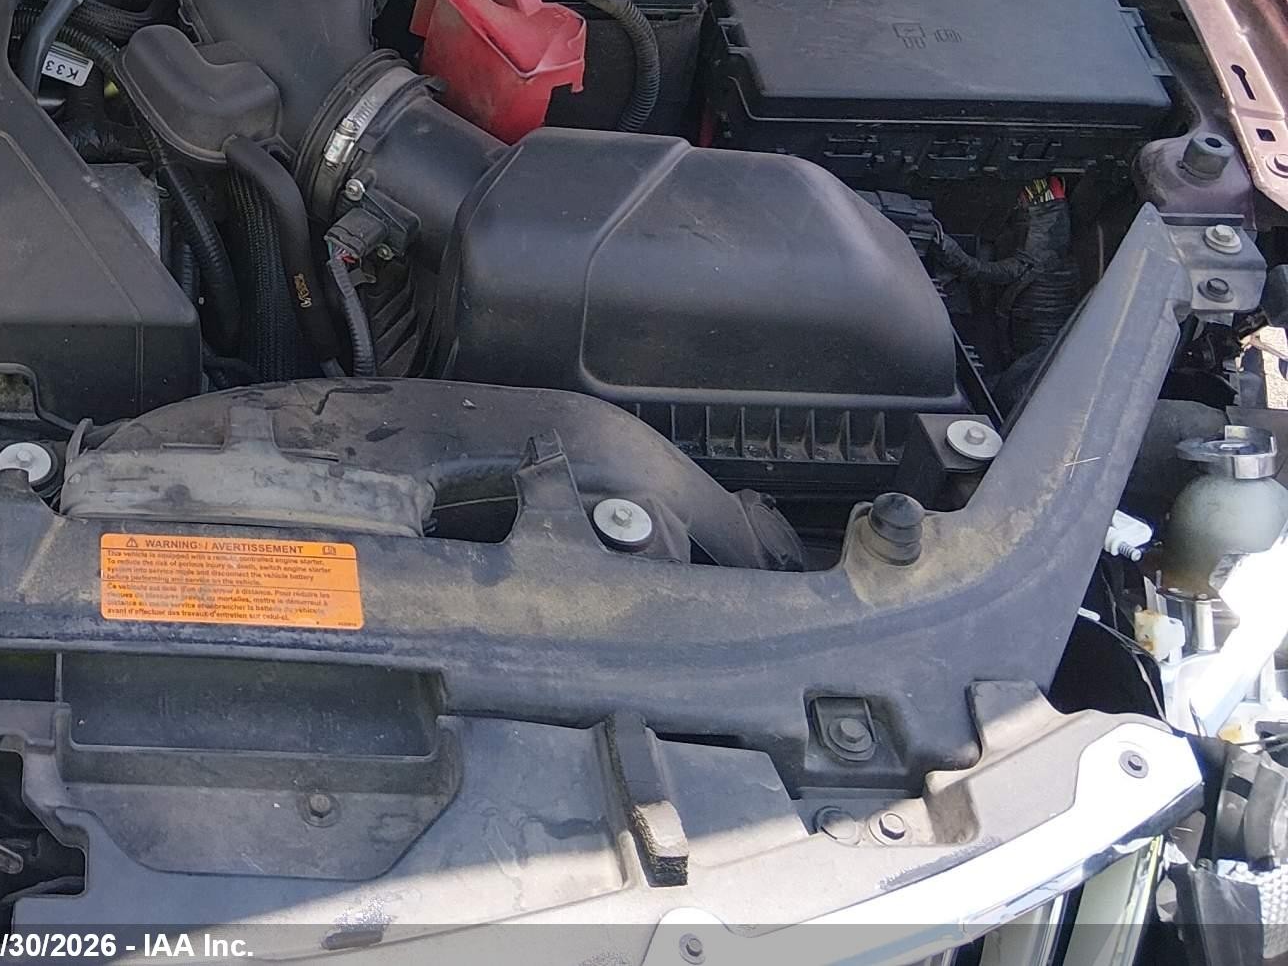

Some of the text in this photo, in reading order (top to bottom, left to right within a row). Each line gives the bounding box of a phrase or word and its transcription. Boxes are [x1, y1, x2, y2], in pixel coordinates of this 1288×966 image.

[45, 60, 79, 80] K33
[145, 539, 200, 549] WARNING:
[211, 542, 304, 553] AVERTISSEMENT
